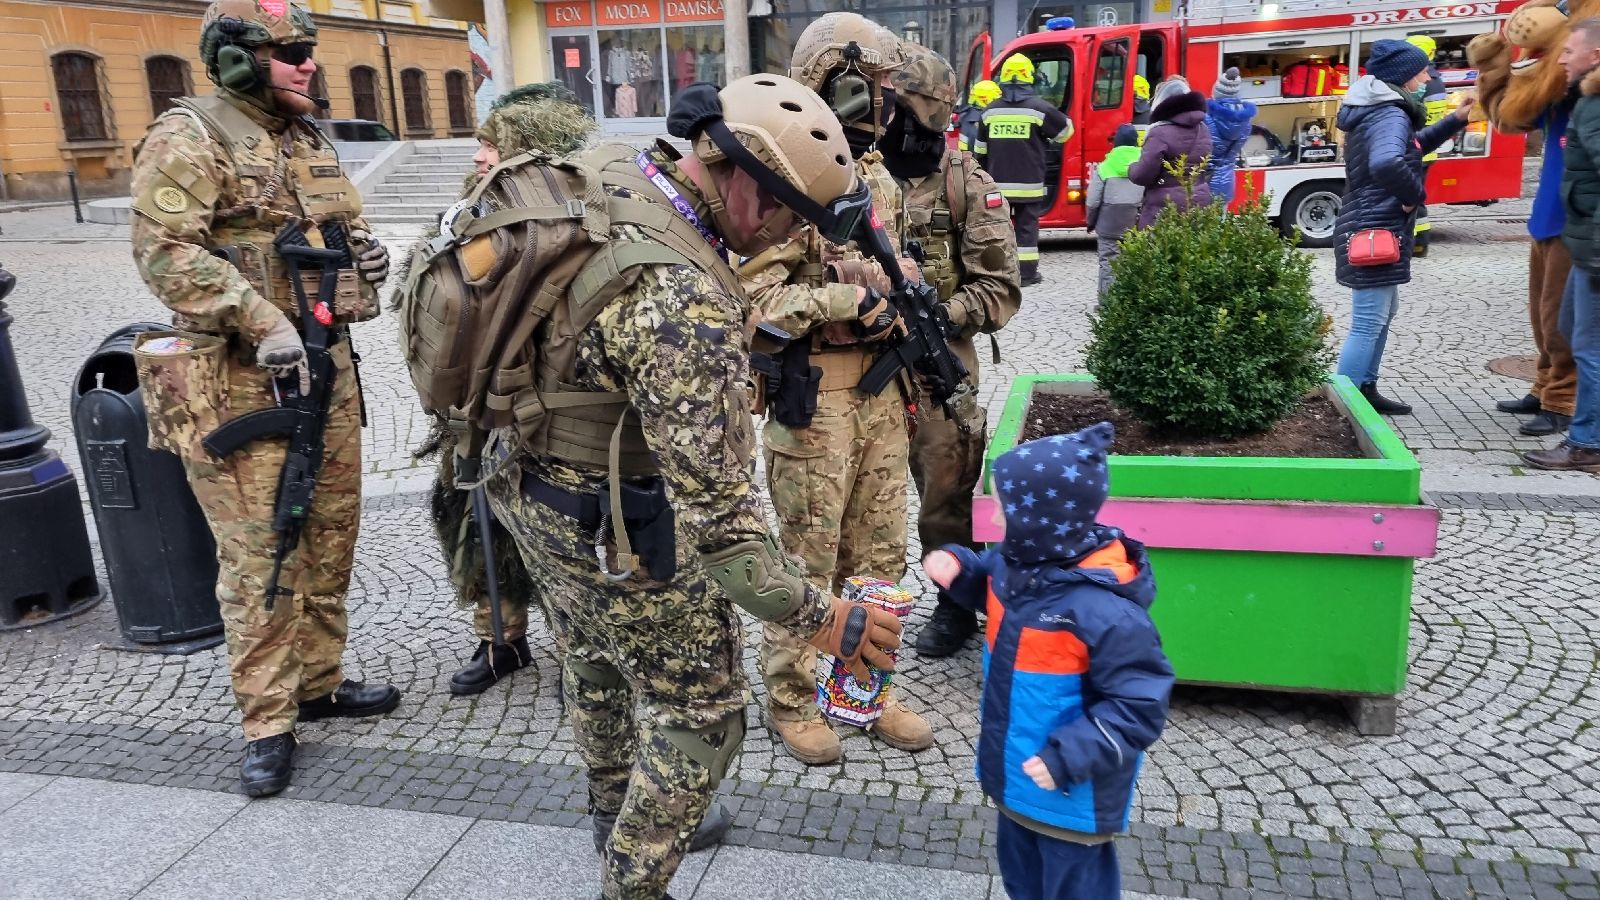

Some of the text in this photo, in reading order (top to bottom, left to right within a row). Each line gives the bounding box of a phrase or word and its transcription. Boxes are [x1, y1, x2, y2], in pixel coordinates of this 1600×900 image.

[555, 0, 725, 21] FOX MODA DAMSKA
[1351, 3, 1499, 25] DRAGON
[654, 175, 676, 196] PLAY
